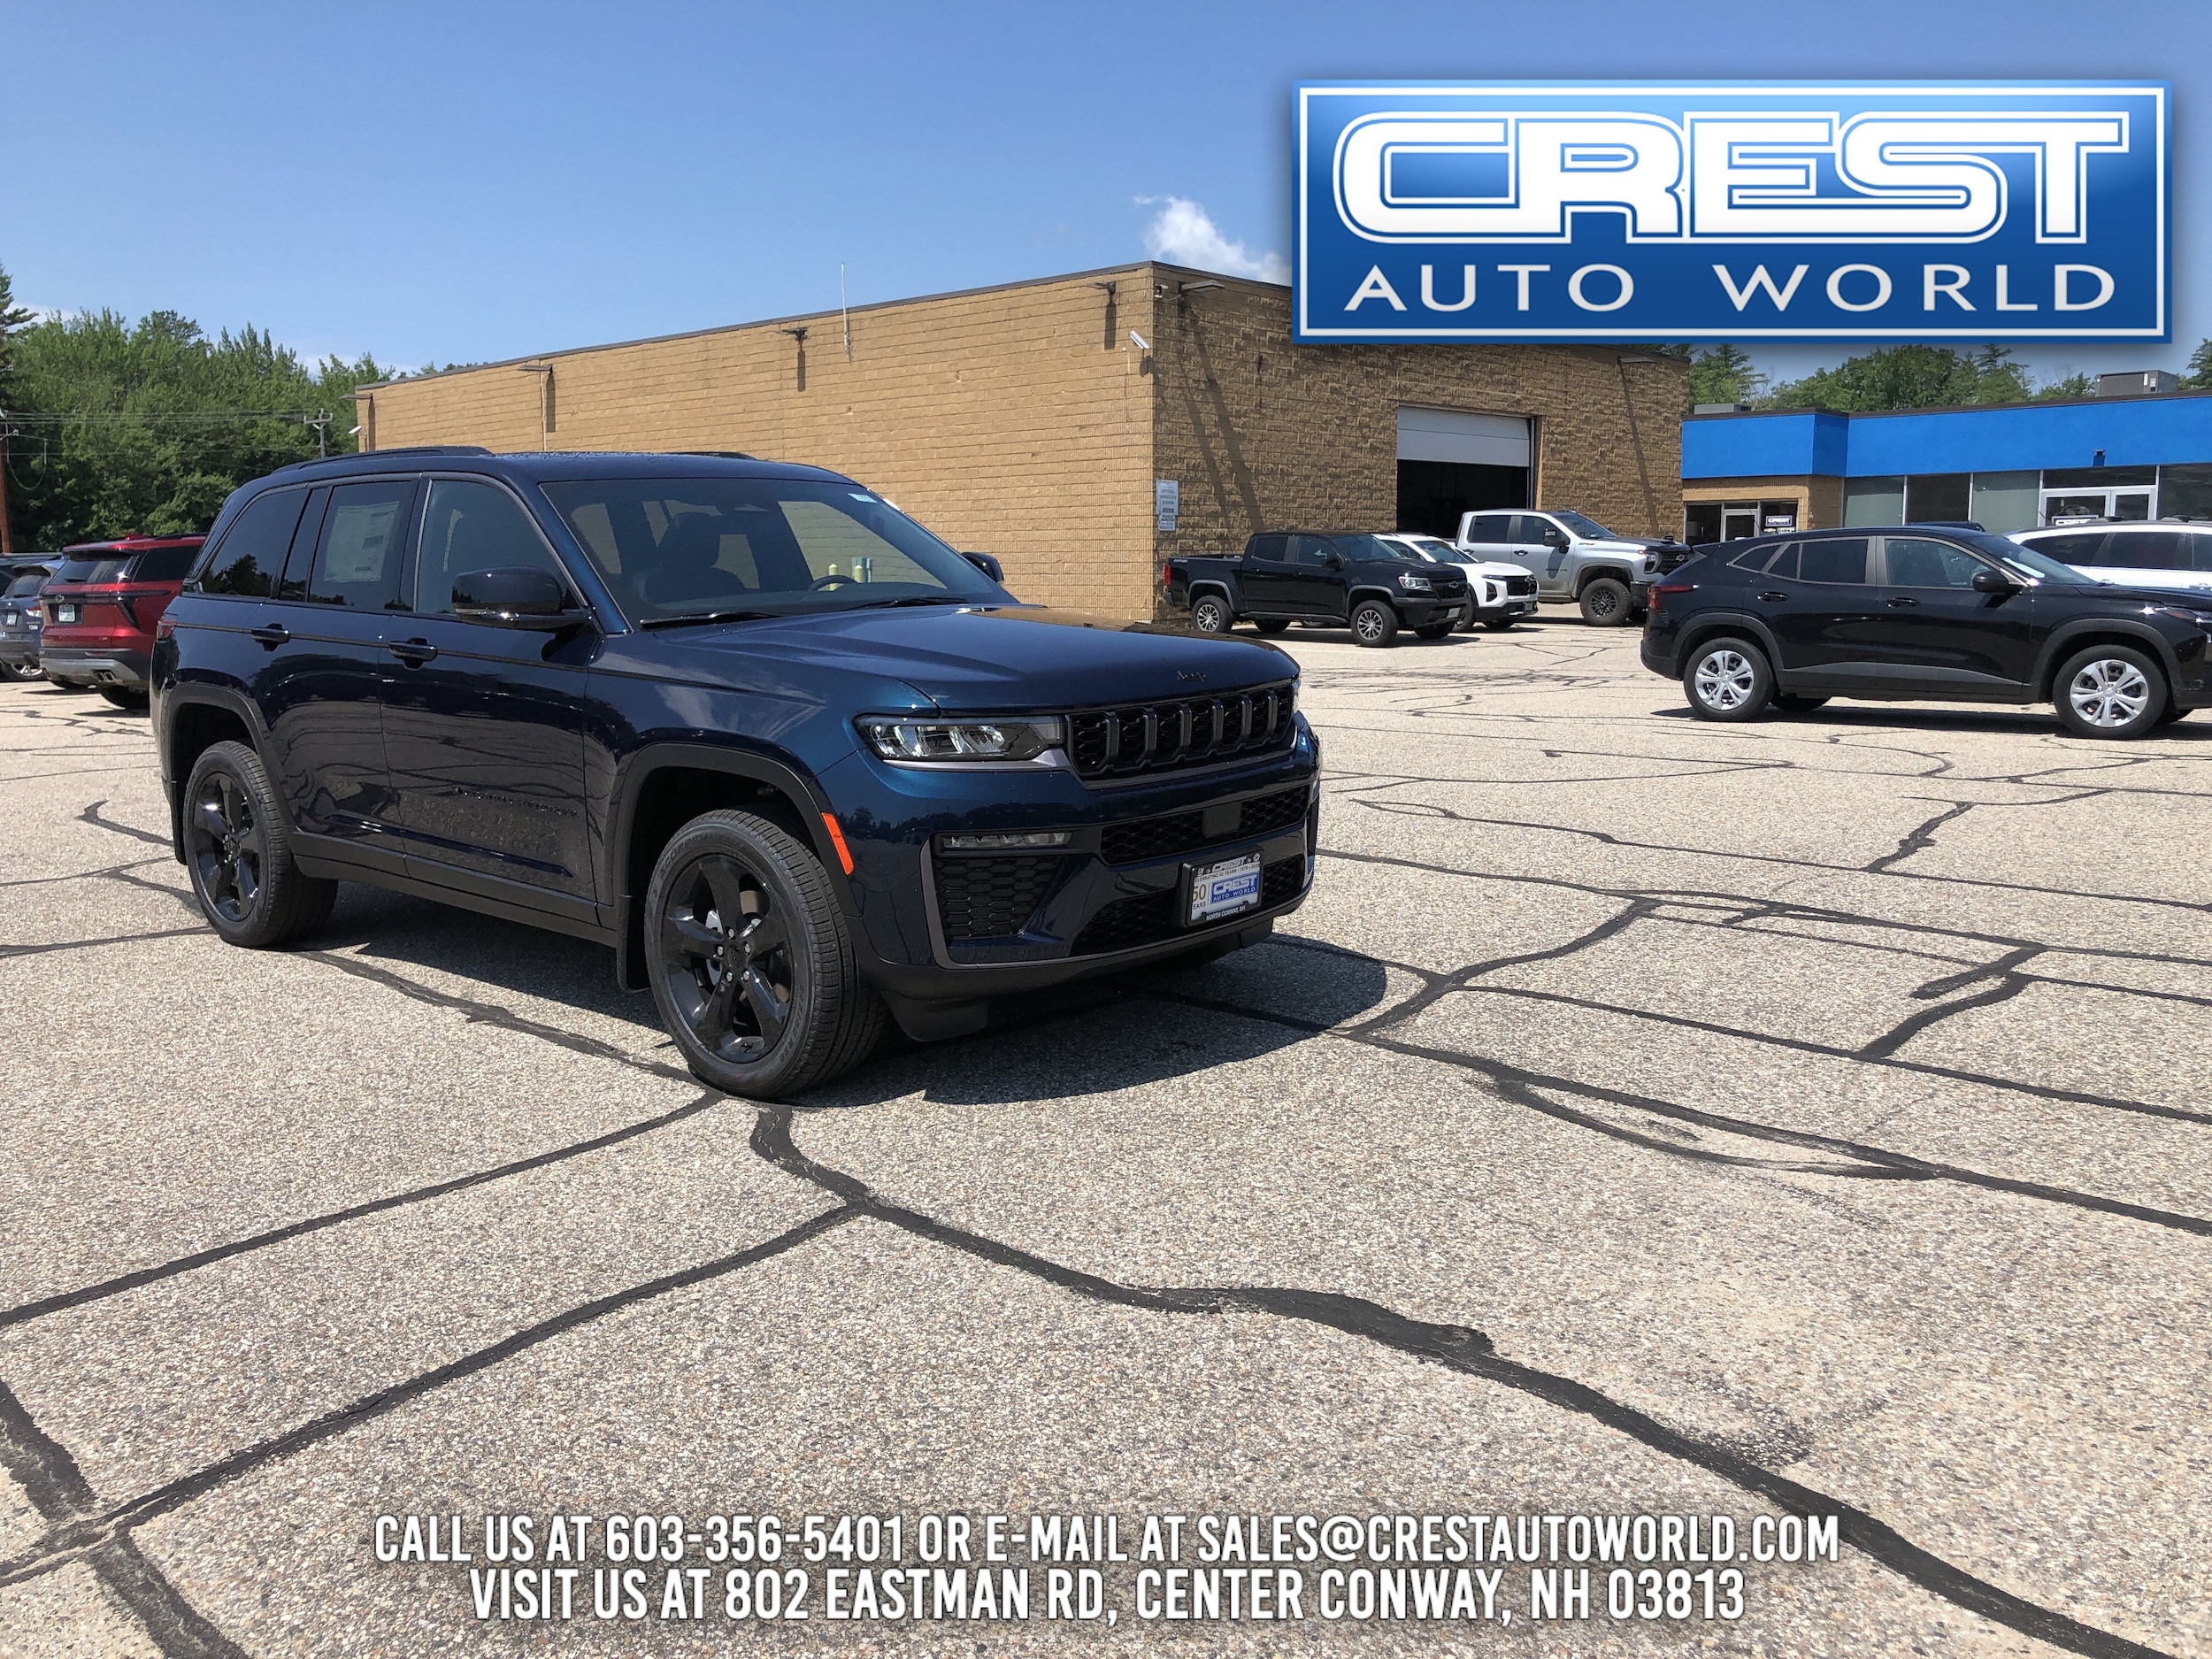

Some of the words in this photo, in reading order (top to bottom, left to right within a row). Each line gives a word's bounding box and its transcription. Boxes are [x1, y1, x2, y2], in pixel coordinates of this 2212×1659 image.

[1213, 875, 1256, 895] CREST
[1213, 892, 1230, 902] AUTO
[1233, 886, 1256, 895] WORLD
